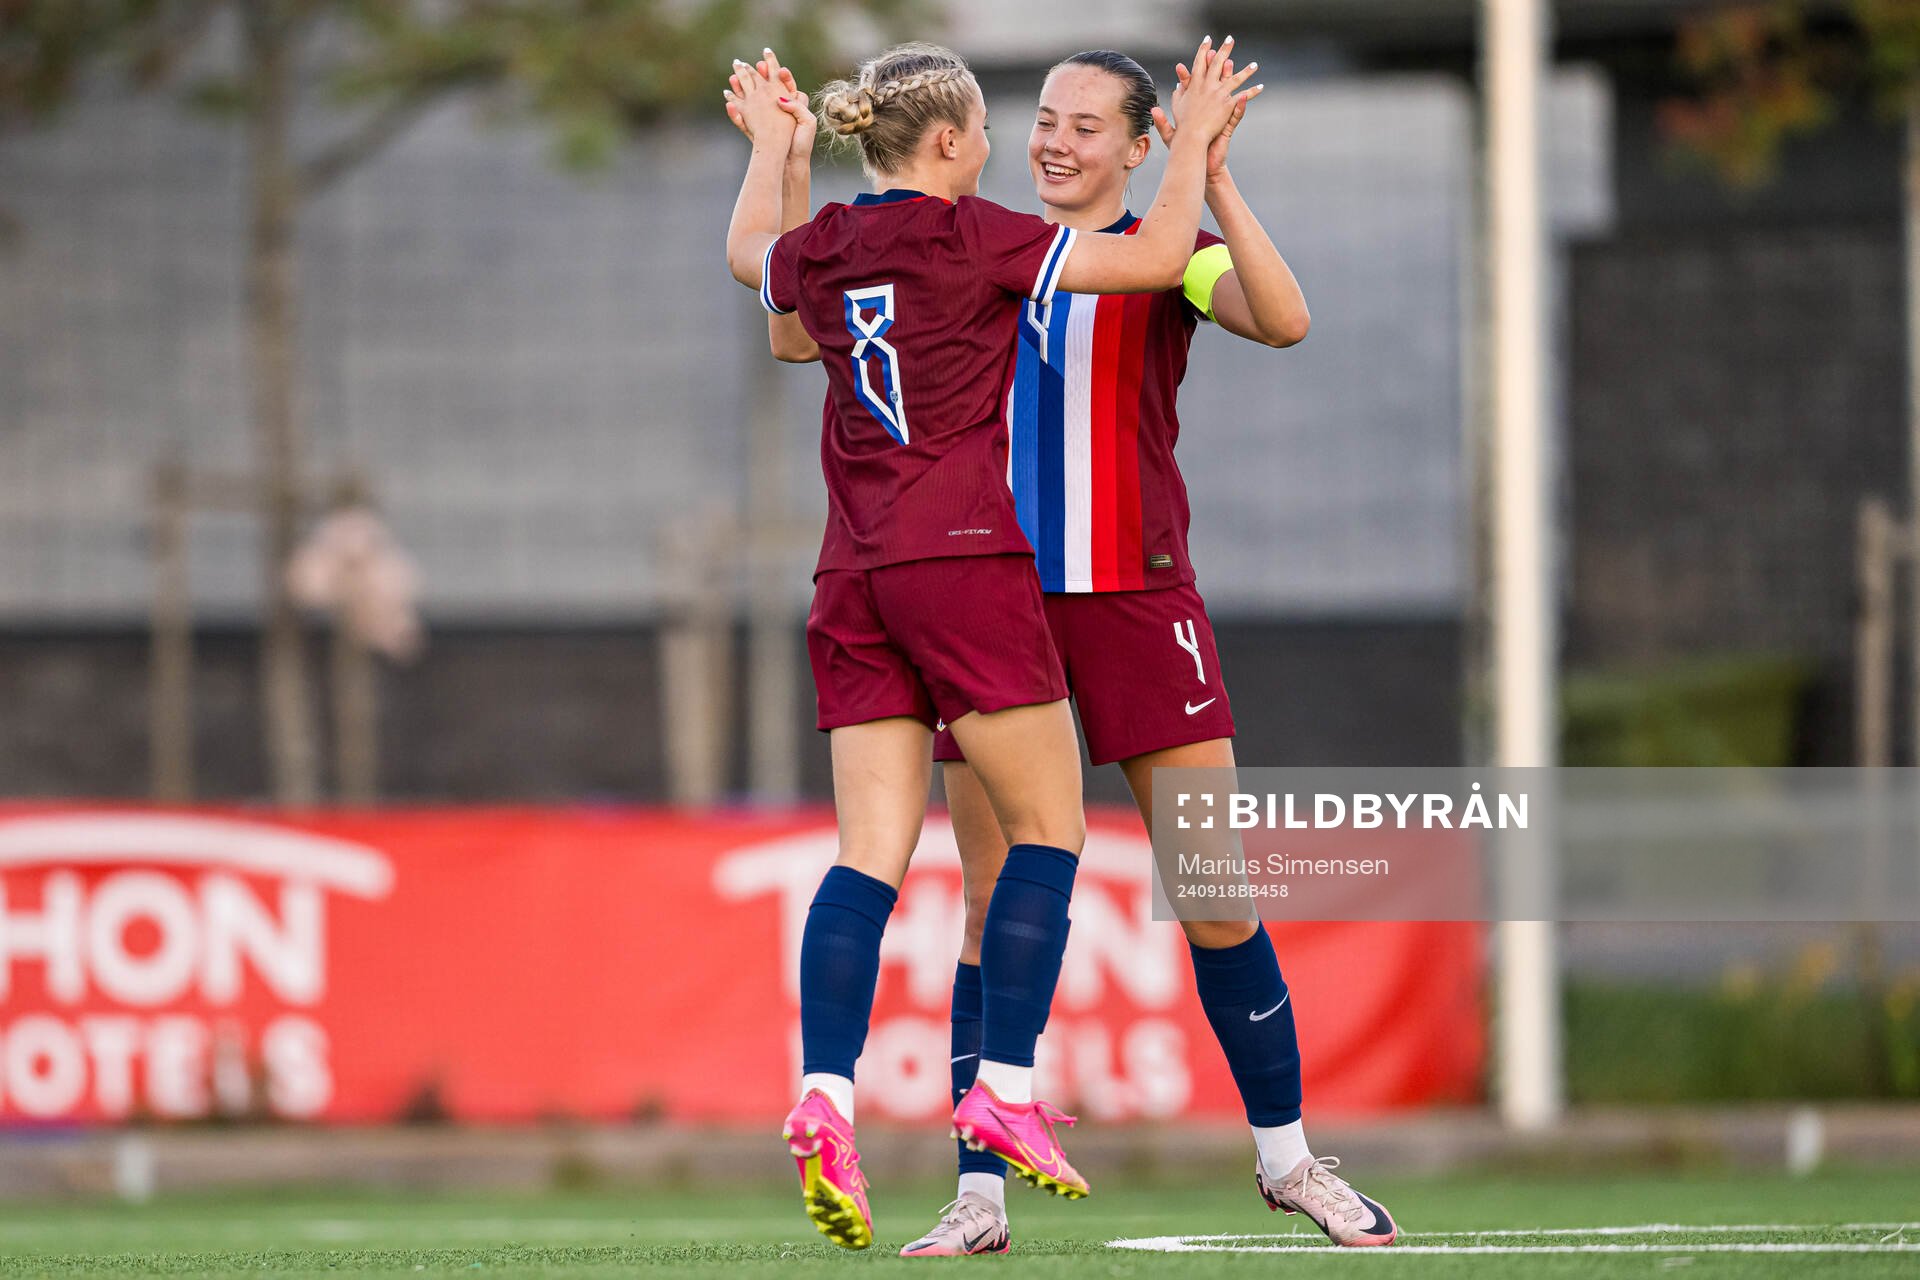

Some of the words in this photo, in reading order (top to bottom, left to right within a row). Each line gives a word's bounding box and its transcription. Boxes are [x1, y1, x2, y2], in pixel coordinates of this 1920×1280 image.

[844, 284, 909, 446] 8
[1027, 299, 1053, 364] 4
[1173, 619, 1206, 685] 4
[0, 862, 327, 1006] HON
[0, 1012, 333, 1119] OTES
